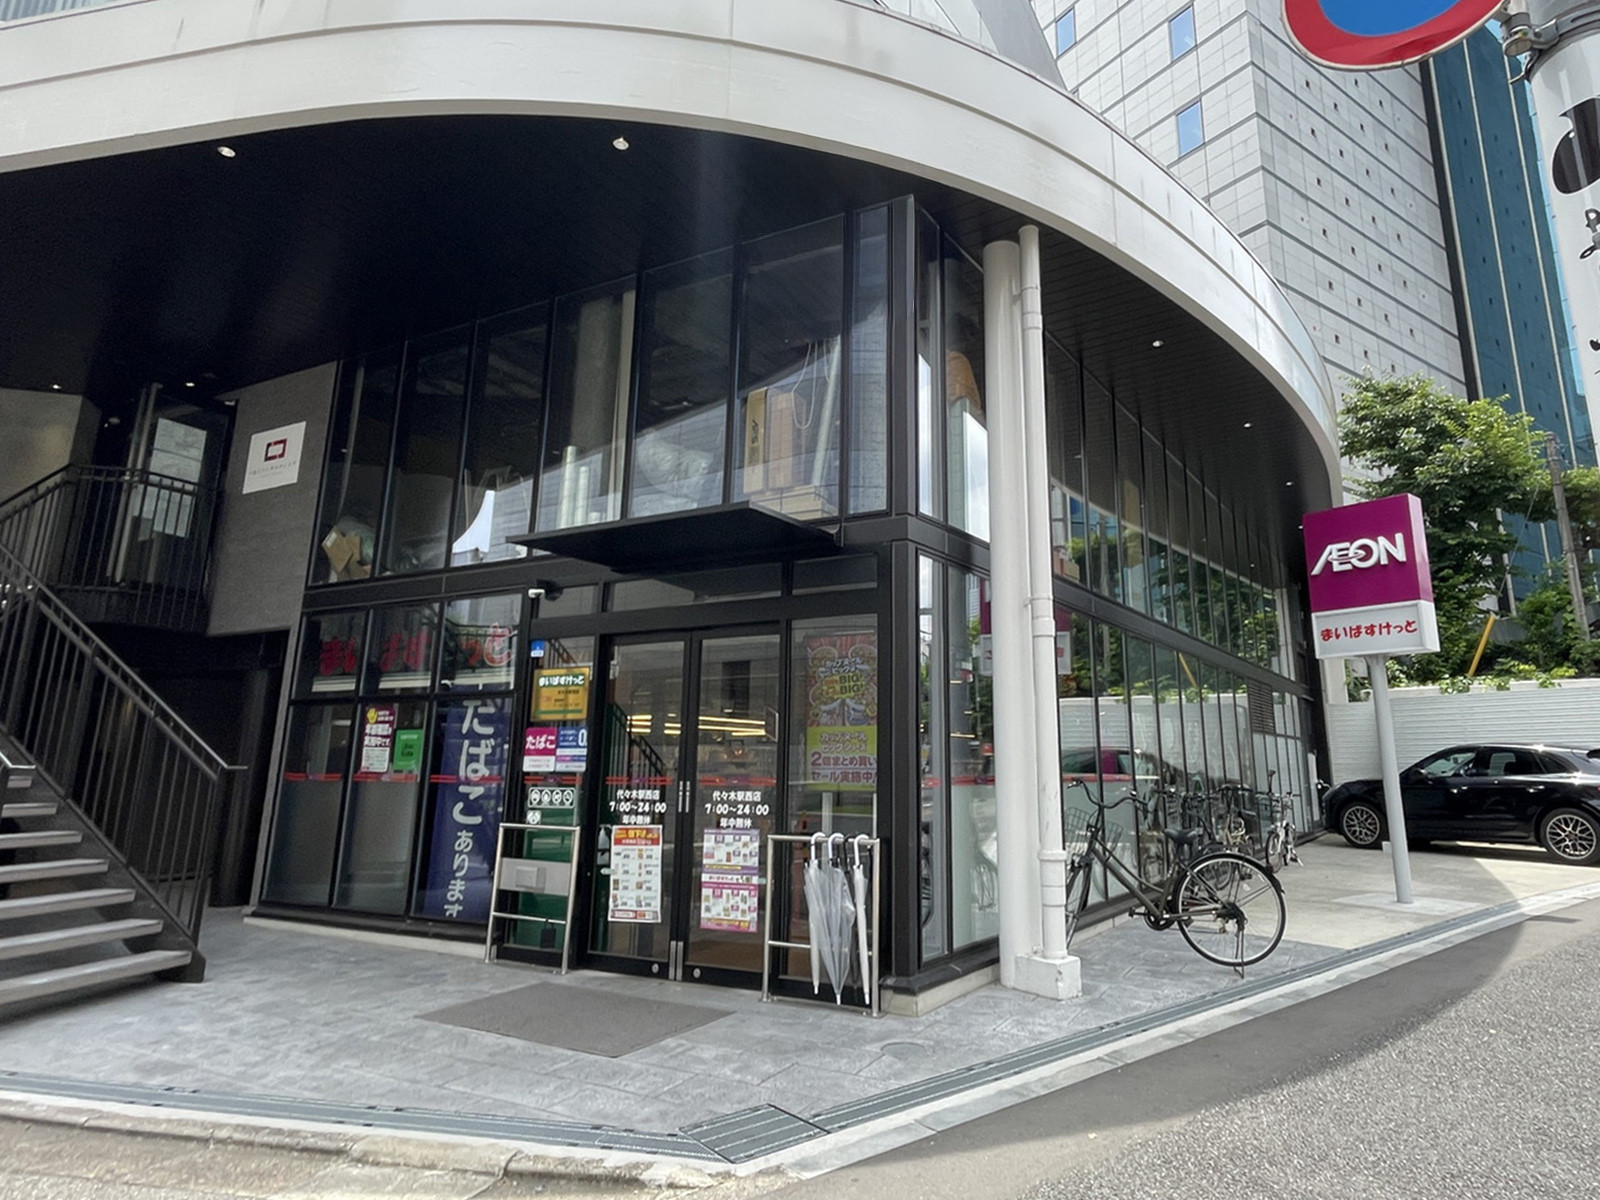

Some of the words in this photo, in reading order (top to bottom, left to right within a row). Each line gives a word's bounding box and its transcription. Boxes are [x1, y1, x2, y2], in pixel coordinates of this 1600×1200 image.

[1310, 532, 1407, 576] AEON
[1320, 620, 1418, 642] まいばすけっと
[538, 675, 585, 687] まいばすけっと
[525, 734, 556, 750] たばこ
[616, 789, 661, 800] 代々木駅西店
[712, 790, 762, 802] 代々木駅西店
[443, 699, 496, 918] たばこあります
[622, 815, 651, 825] 年中無休
[720, 817, 753, 829] 年中無休
